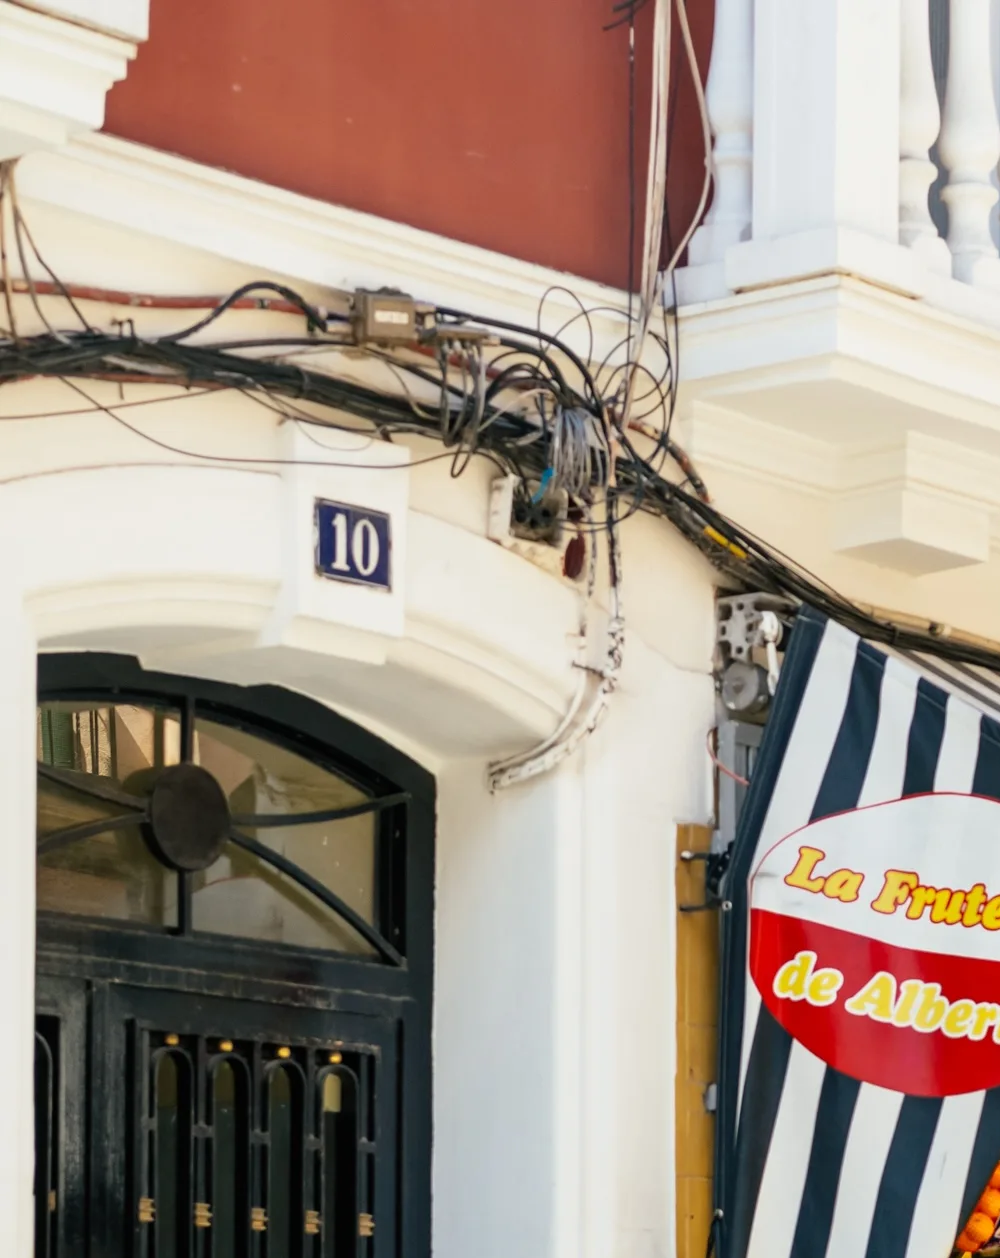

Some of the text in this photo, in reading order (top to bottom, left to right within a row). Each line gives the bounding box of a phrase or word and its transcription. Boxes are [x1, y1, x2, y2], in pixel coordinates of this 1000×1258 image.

[331, 513, 380, 577] 10
[784, 846, 865, 903] La
[773, 951, 844, 1006] de
